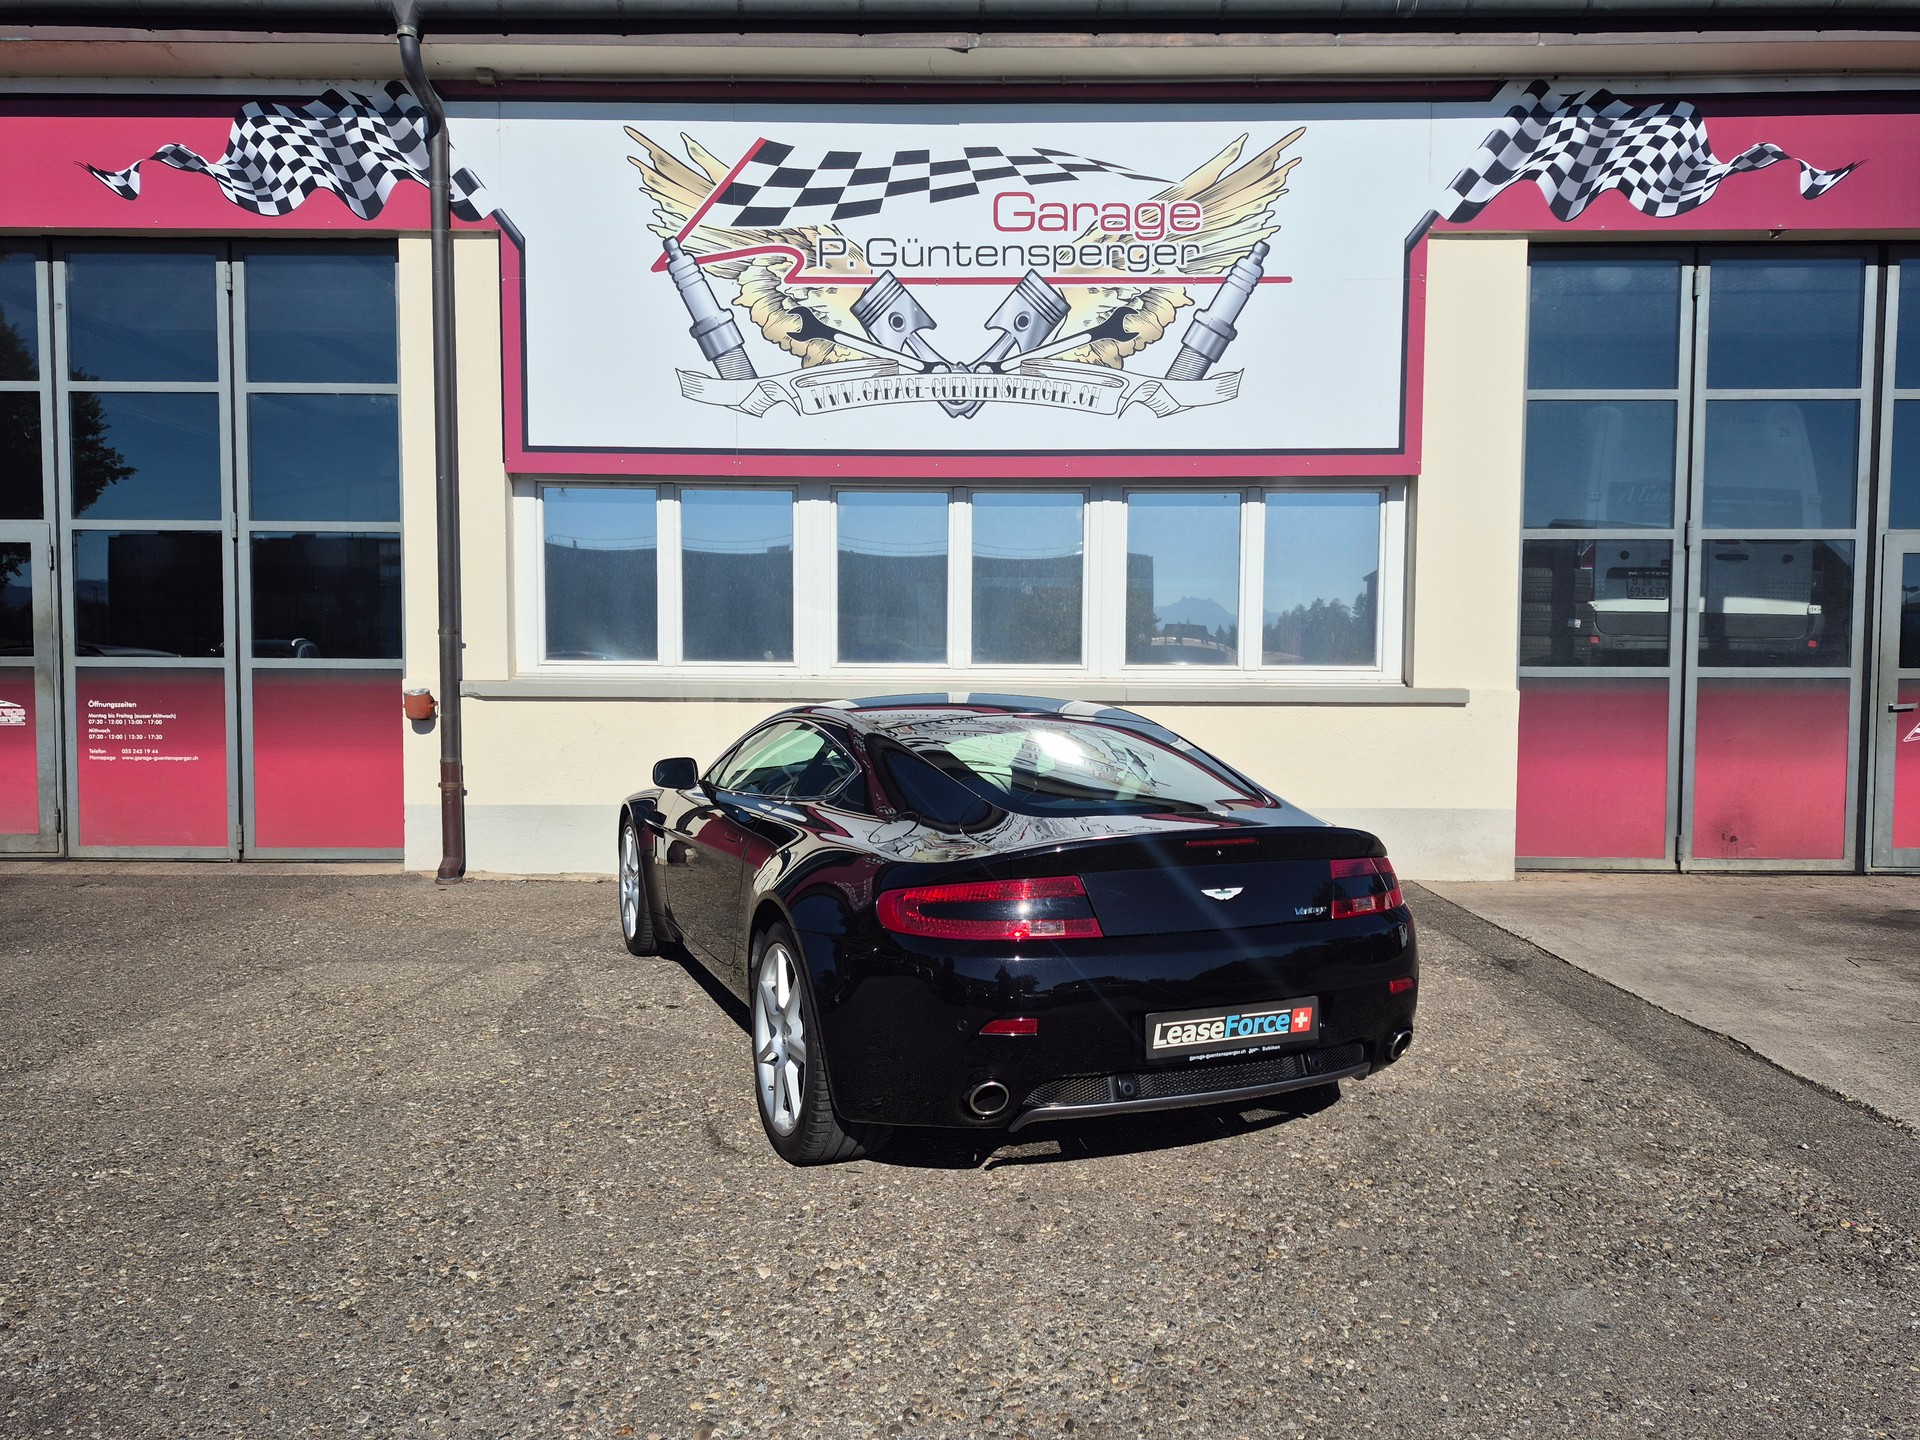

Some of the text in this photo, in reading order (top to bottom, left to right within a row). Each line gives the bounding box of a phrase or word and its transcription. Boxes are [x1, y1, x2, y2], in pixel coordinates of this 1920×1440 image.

[993, 191, 1202, 240] Garage
[816, 237, 1201, 272] P. Güntensperger
[811, 376, 1103, 411] WWW.GARAGE-GUENTENSPERGER.CH
[88, 700, 137, 709] Öffnungszeiten
[1294, 906, 1328, 916] Vantage
[1152, 1014, 1290, 1047] LeaseForce
